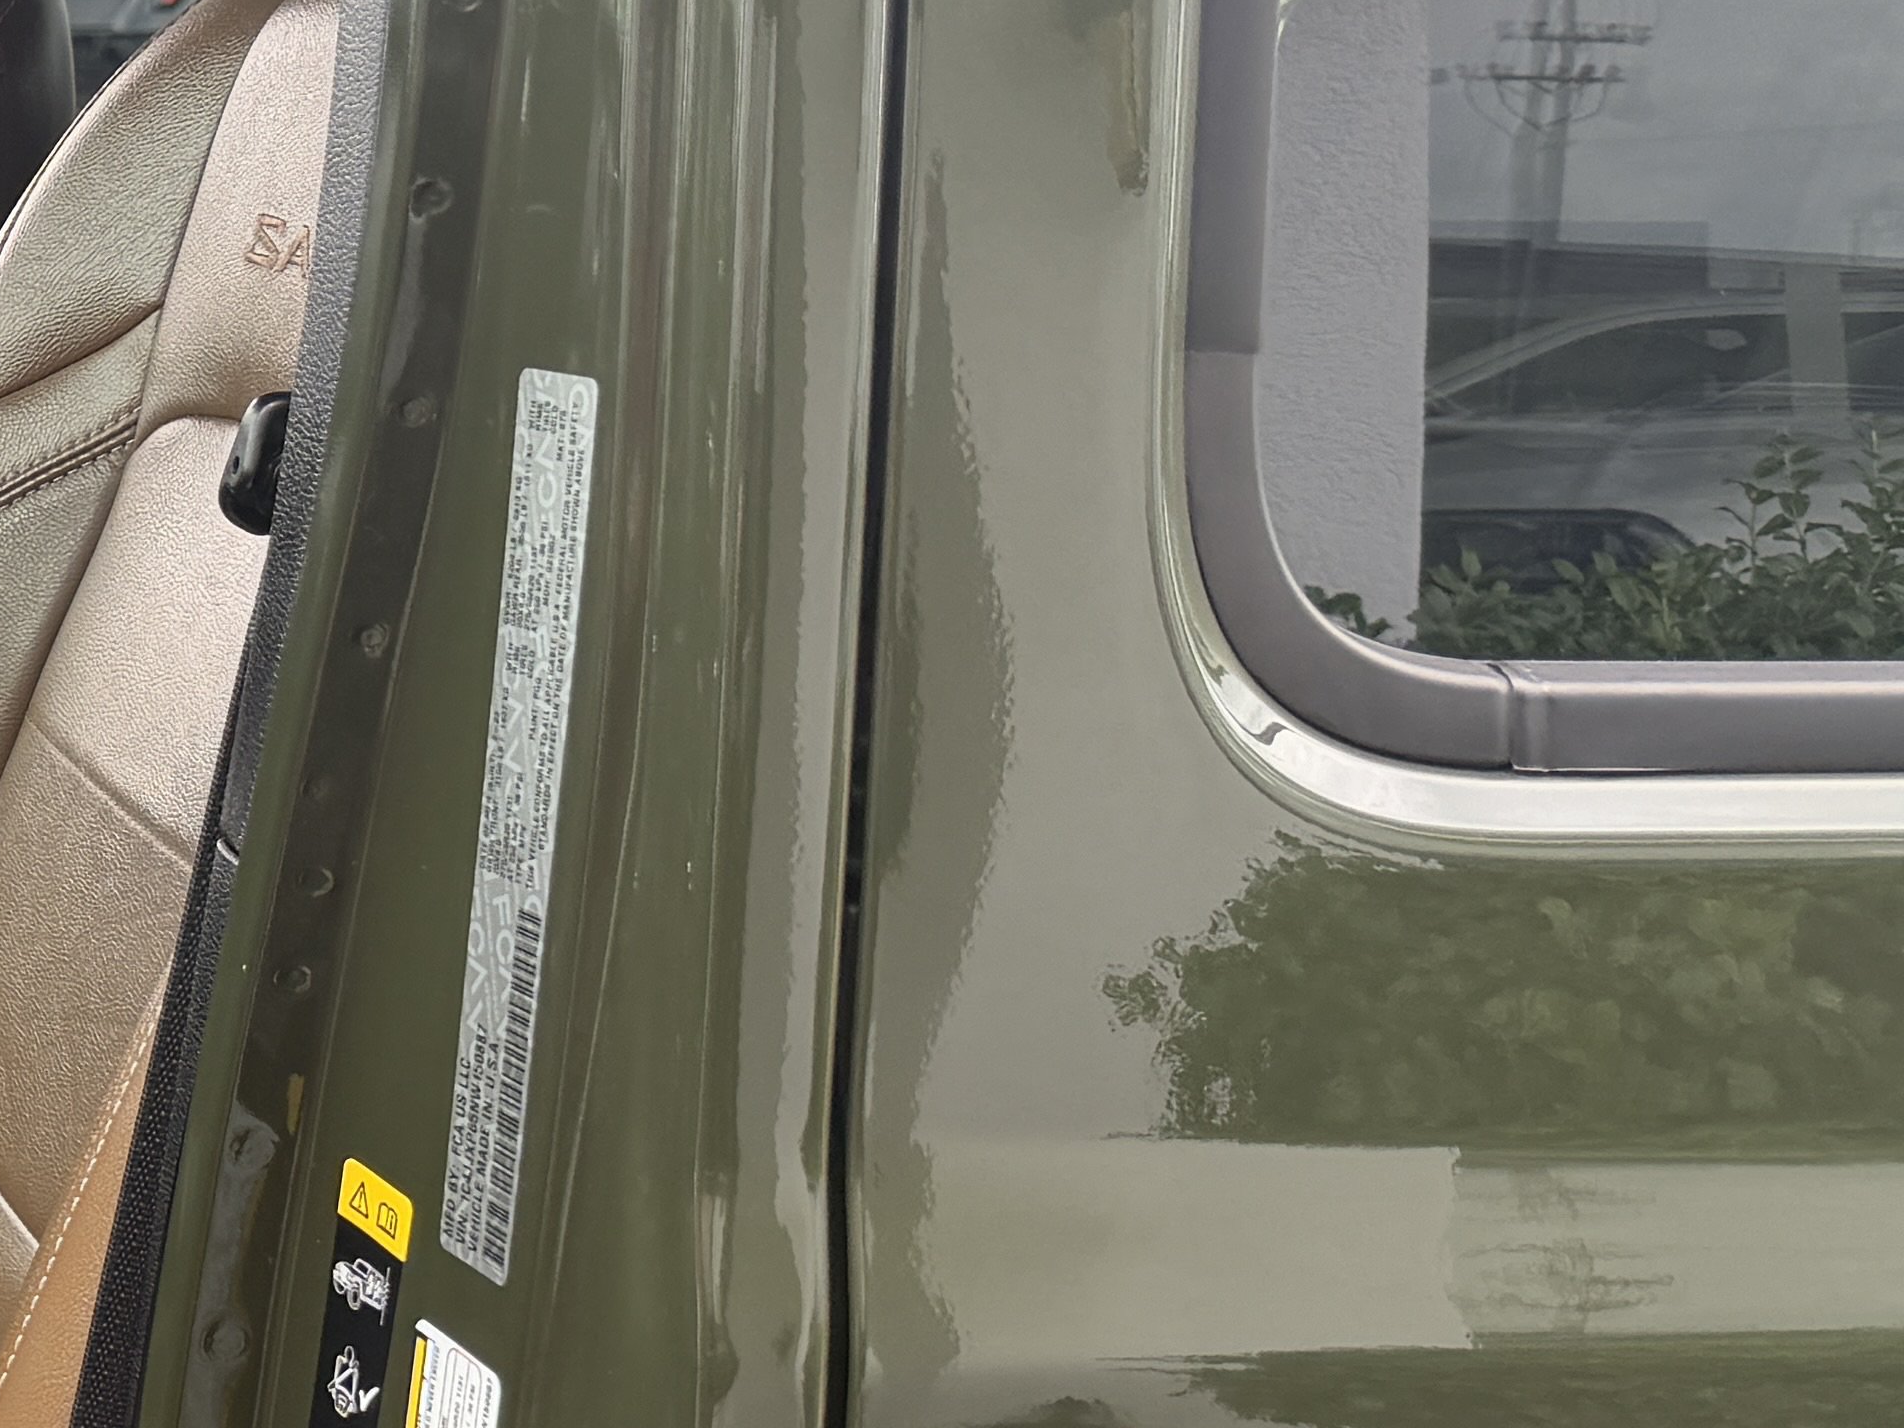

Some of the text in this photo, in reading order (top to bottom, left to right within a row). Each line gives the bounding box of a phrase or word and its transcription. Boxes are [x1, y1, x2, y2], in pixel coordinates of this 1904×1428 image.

[456, 1054, 470, 1090] LLC
[454, 1091, 467, 1119] US
[450, 1120, 464, 1158] FCA
[475, 1122, 490, 1178] MADE
[467, 1179, 485, 1255] VEHICLE
